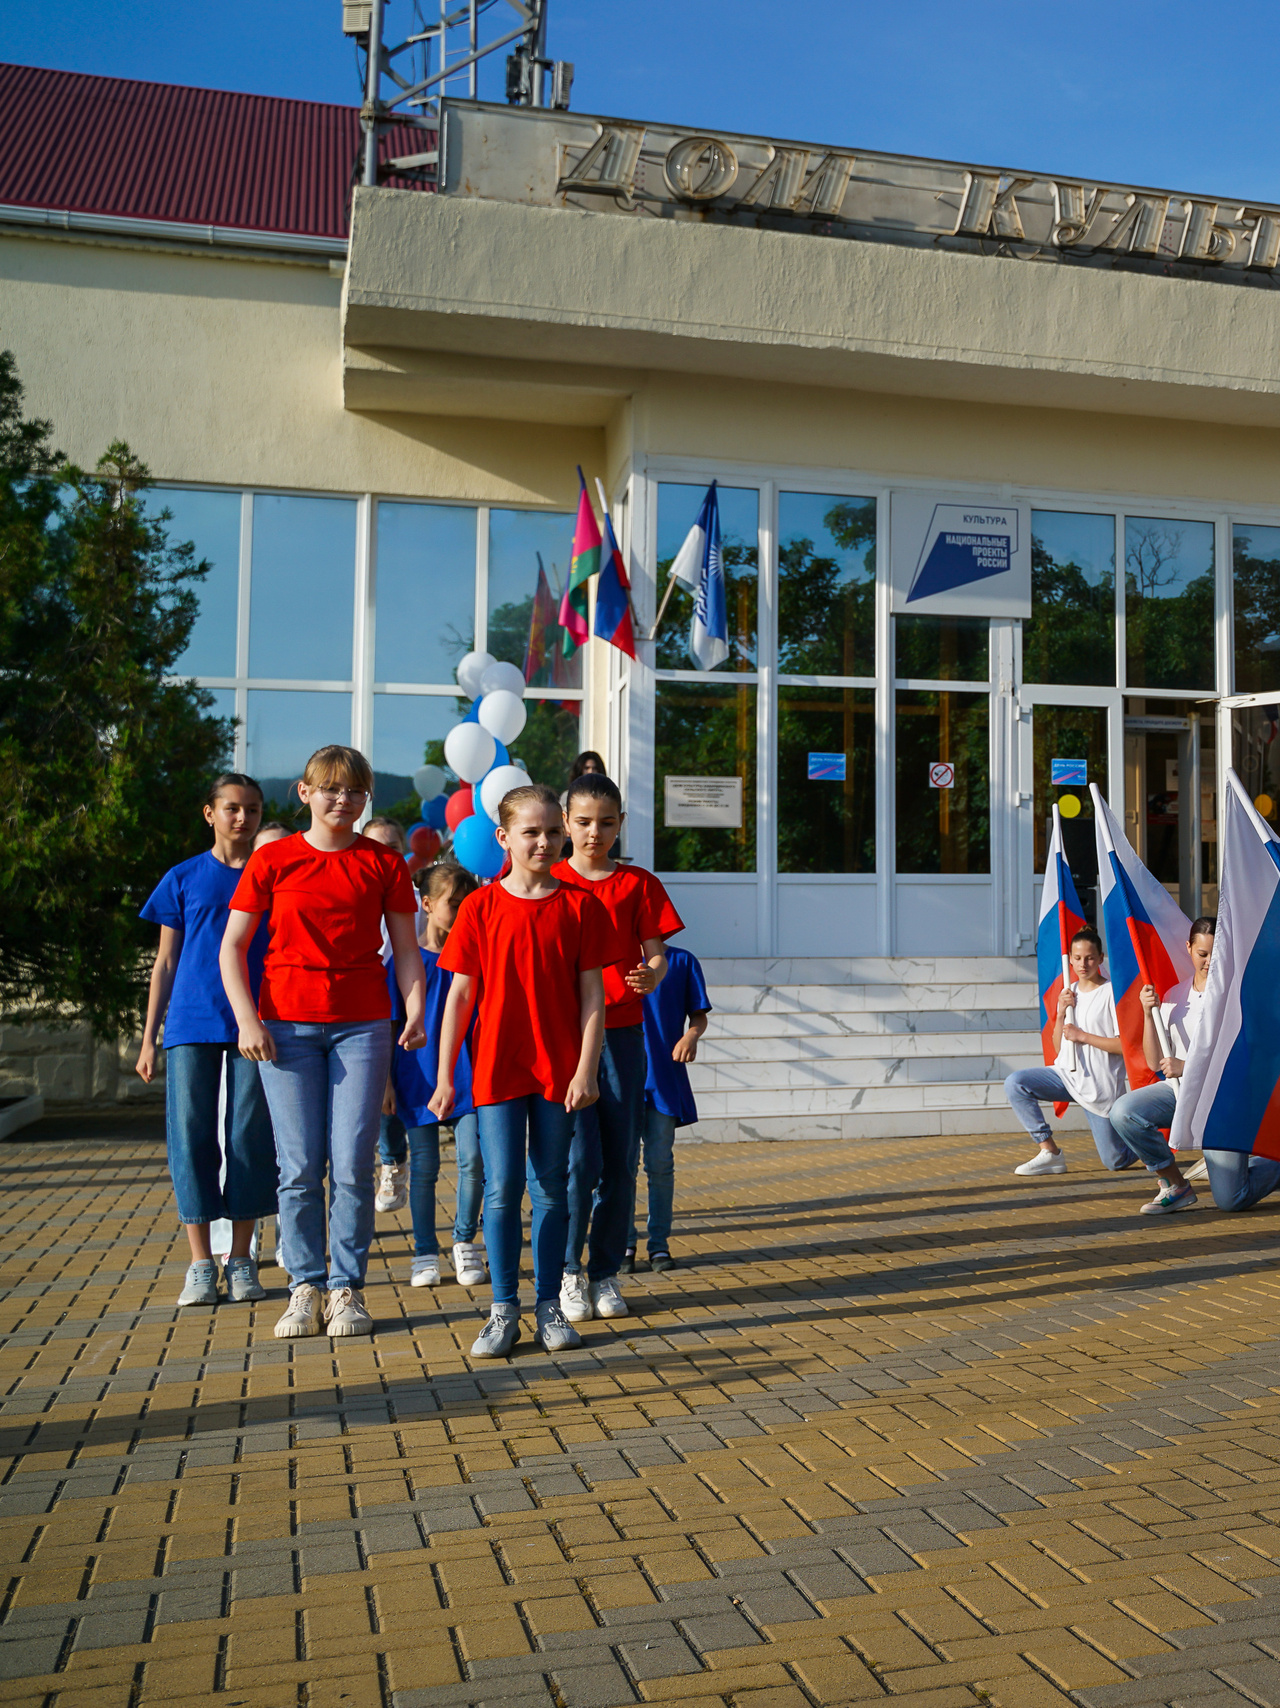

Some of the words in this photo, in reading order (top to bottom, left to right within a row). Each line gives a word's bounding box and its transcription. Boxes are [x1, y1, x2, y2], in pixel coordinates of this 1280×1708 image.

[556, 123, 855, 219] ДОМ
[963, 514, 1007, 525] КУЛЬТУРА
[945, 534, 1008, 547] НАЦИОНАЛЬНЫЕ
[972, 546, 1008, 558] ПРОЕКТЫ
[977, 557, 1008, 568] РОССИИ
